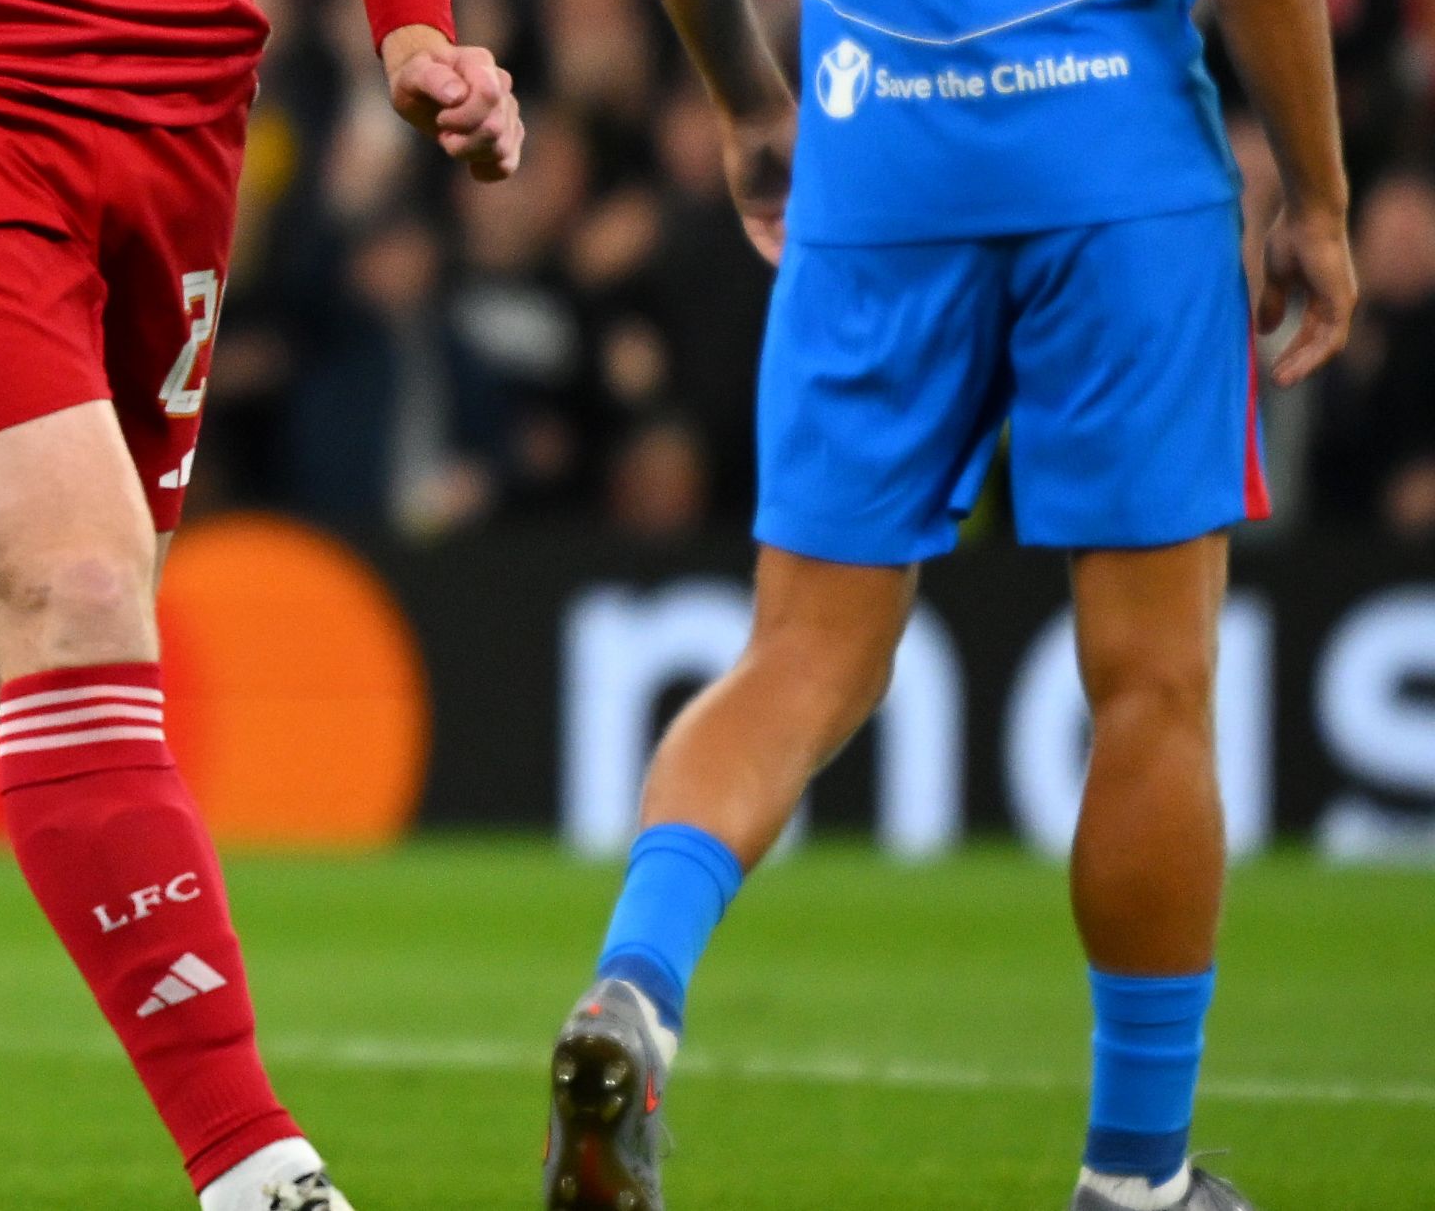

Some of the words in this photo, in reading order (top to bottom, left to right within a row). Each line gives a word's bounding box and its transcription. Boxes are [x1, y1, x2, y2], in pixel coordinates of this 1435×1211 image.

[875, 69, 931, 99] Save
[937, 72, 985, 96] the
[990, 55, 1129, 94] Children
[92, 871, 201, 933] LFC
